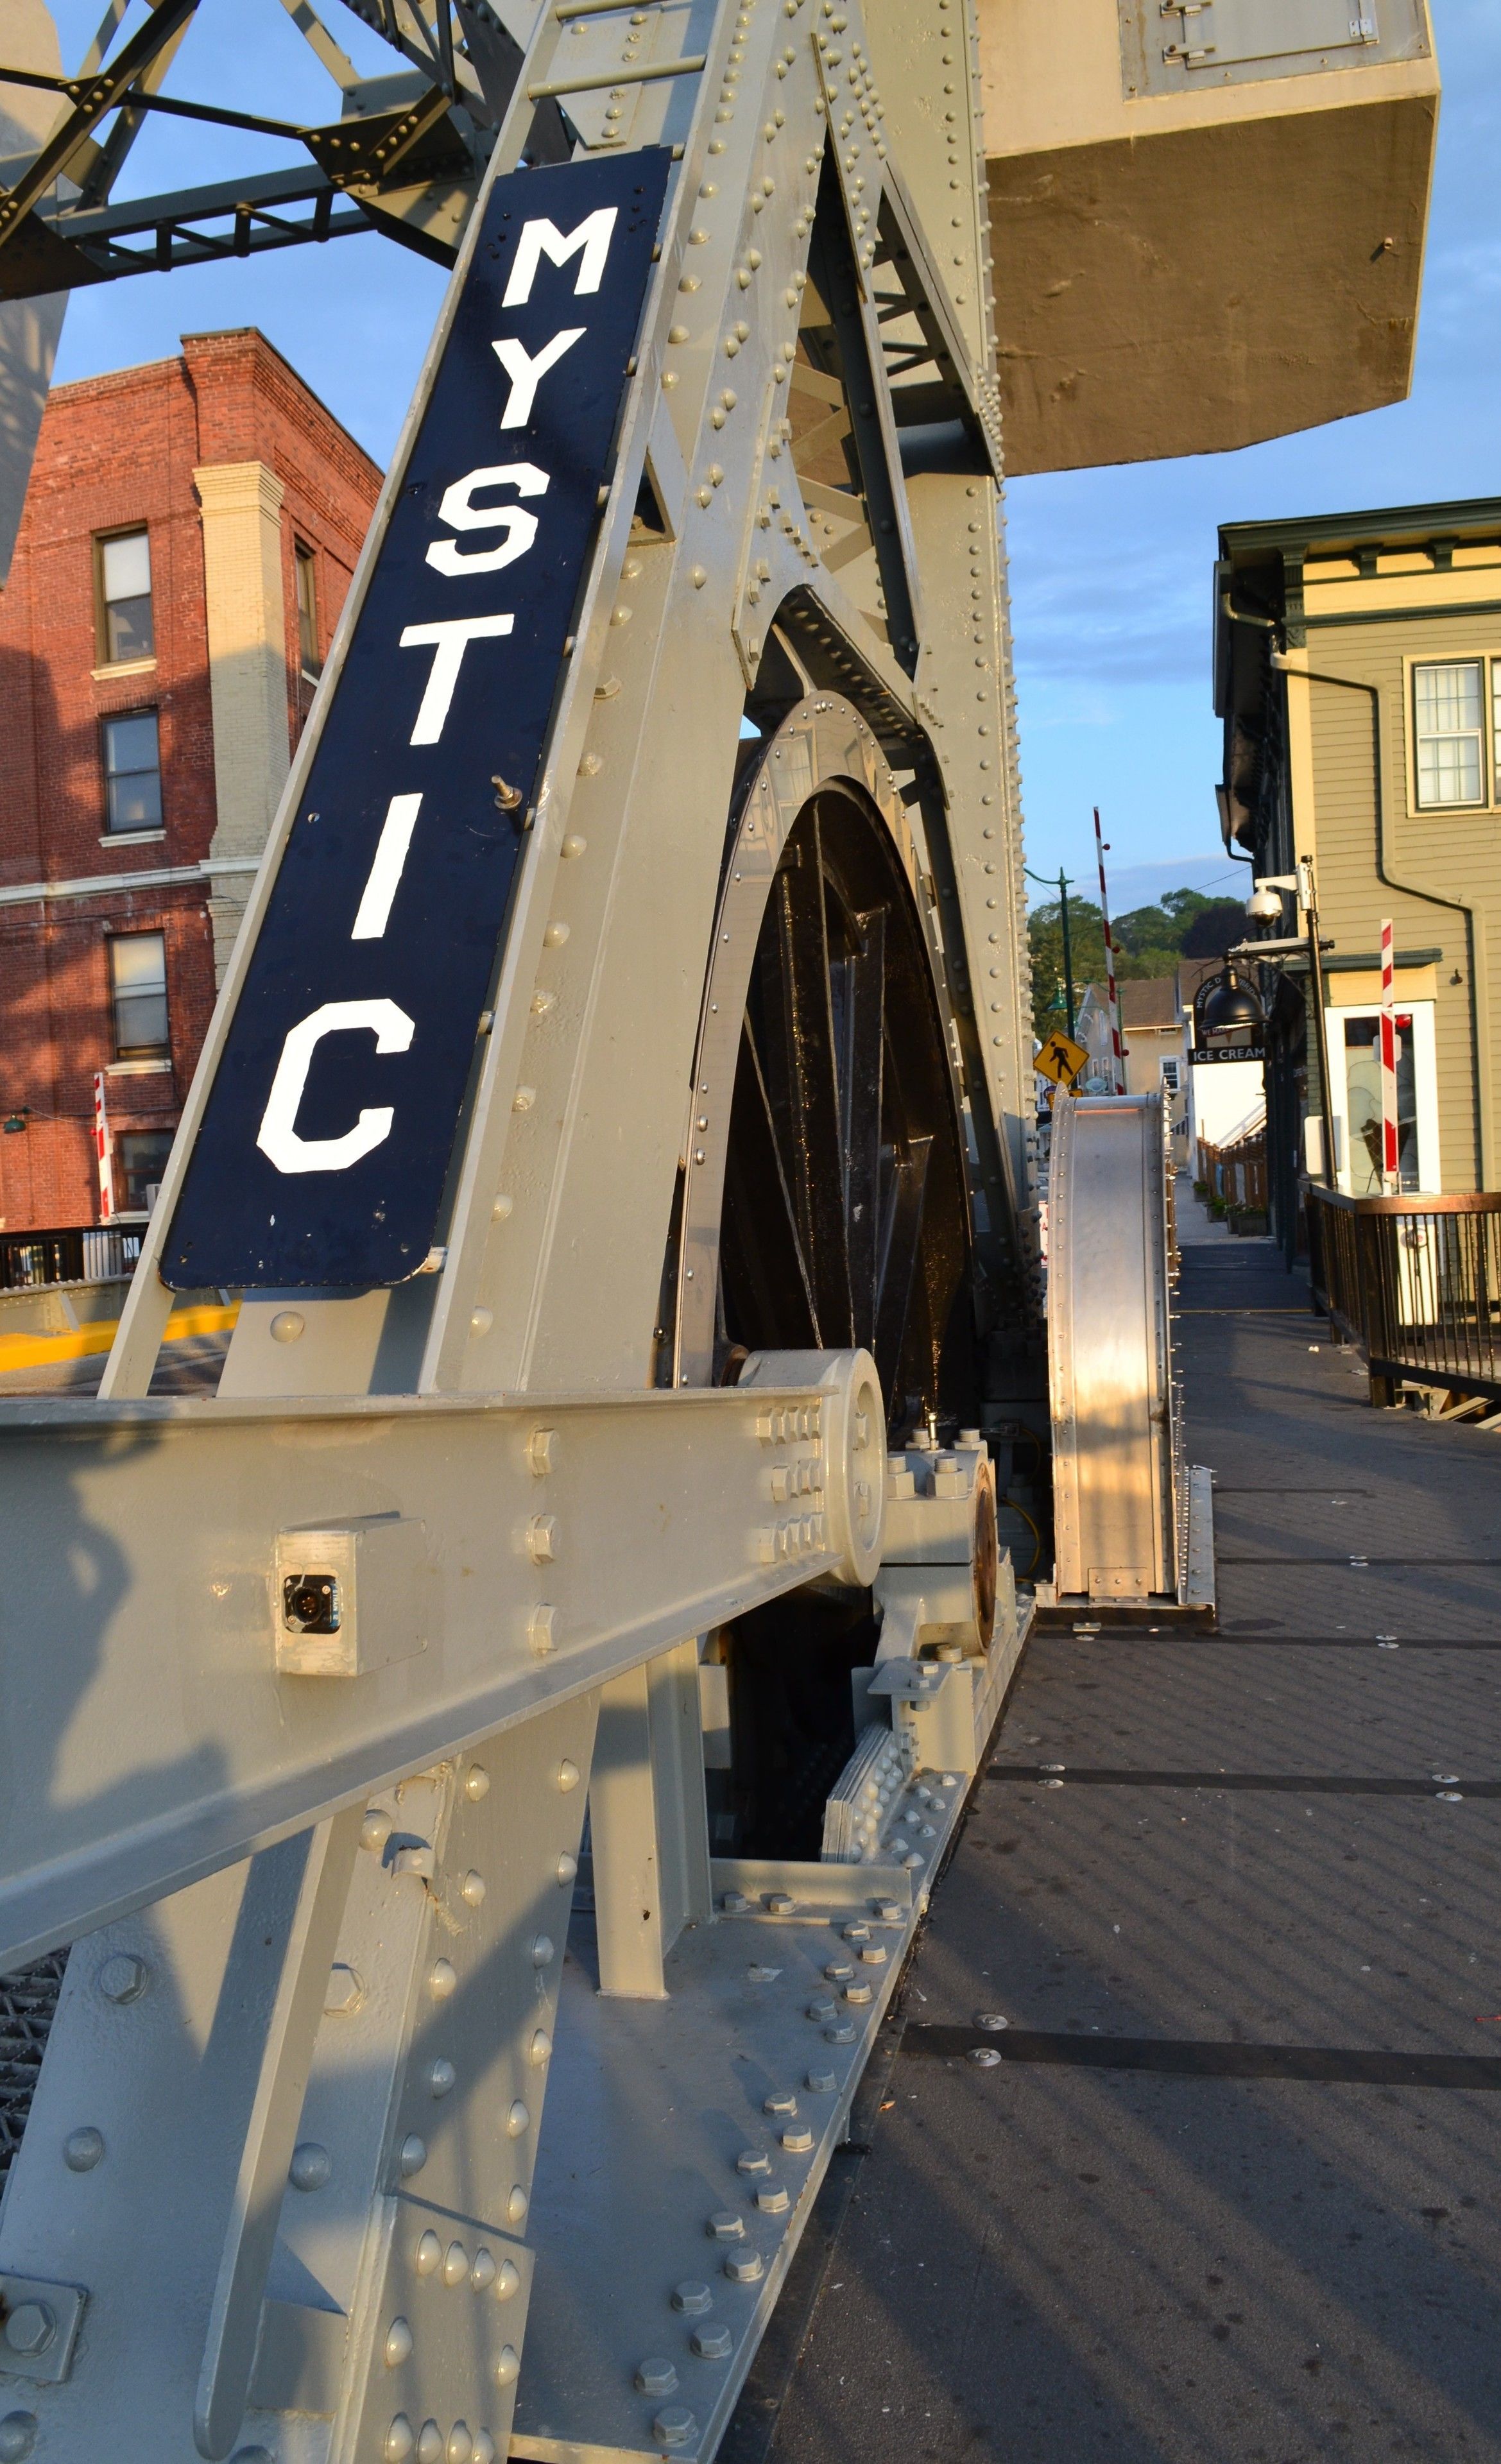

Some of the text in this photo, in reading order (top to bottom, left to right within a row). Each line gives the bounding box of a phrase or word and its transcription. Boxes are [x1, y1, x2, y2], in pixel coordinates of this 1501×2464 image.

[256, 207, 618, 1174] MYSTIC
[1196, 982, 1214, 1008] MYSTIC
[1194, 1047, 1265, 1061] ICE CREAM
